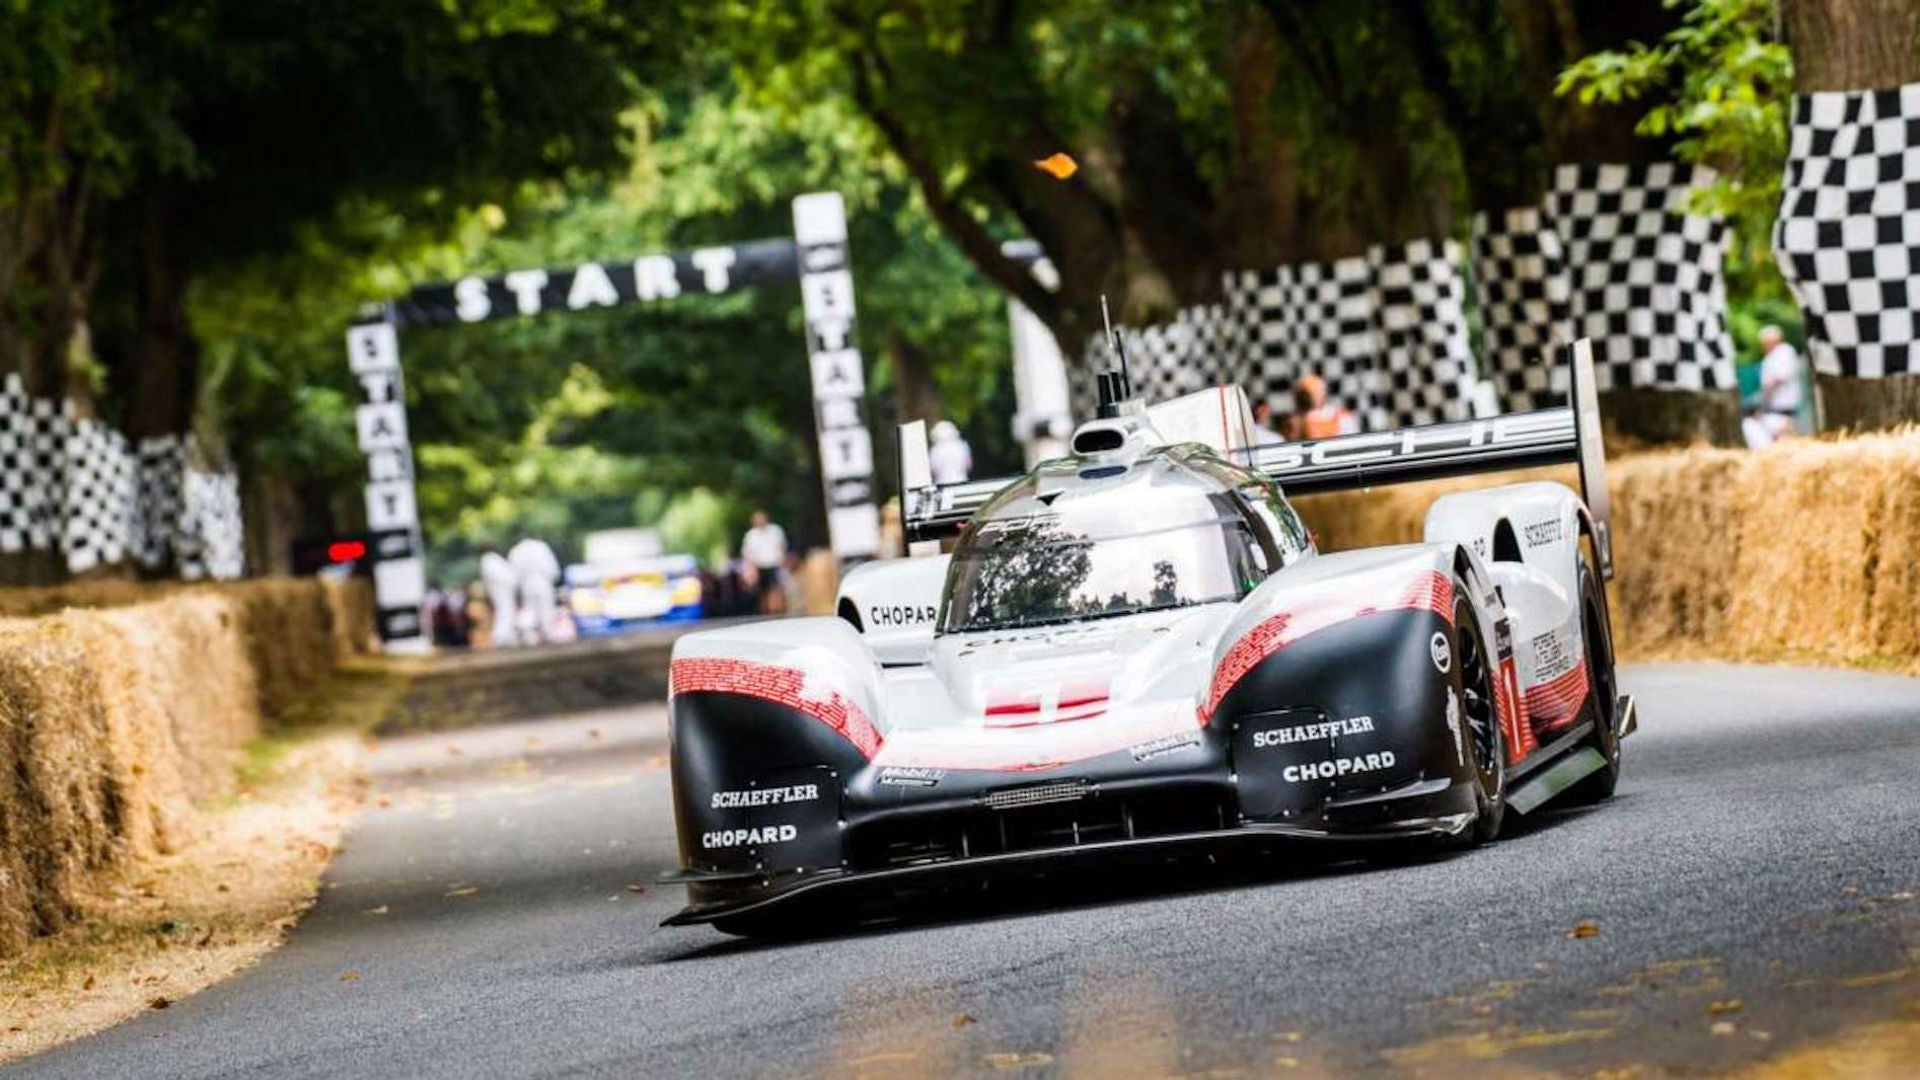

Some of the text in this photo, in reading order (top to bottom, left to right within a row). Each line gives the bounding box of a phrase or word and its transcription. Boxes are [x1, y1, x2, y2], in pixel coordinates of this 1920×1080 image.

[453, 246, 737, 322] START
[871, 605, 937, 626] CHOPAR
[1253, 716, 1375, 748] SCHAEFFLER
[1283, 751, 1396, 783] CHOPARD
[711, 783, 819, 808] SCHAEFFLER
[702, 824, 797, 848] CHOPARD
